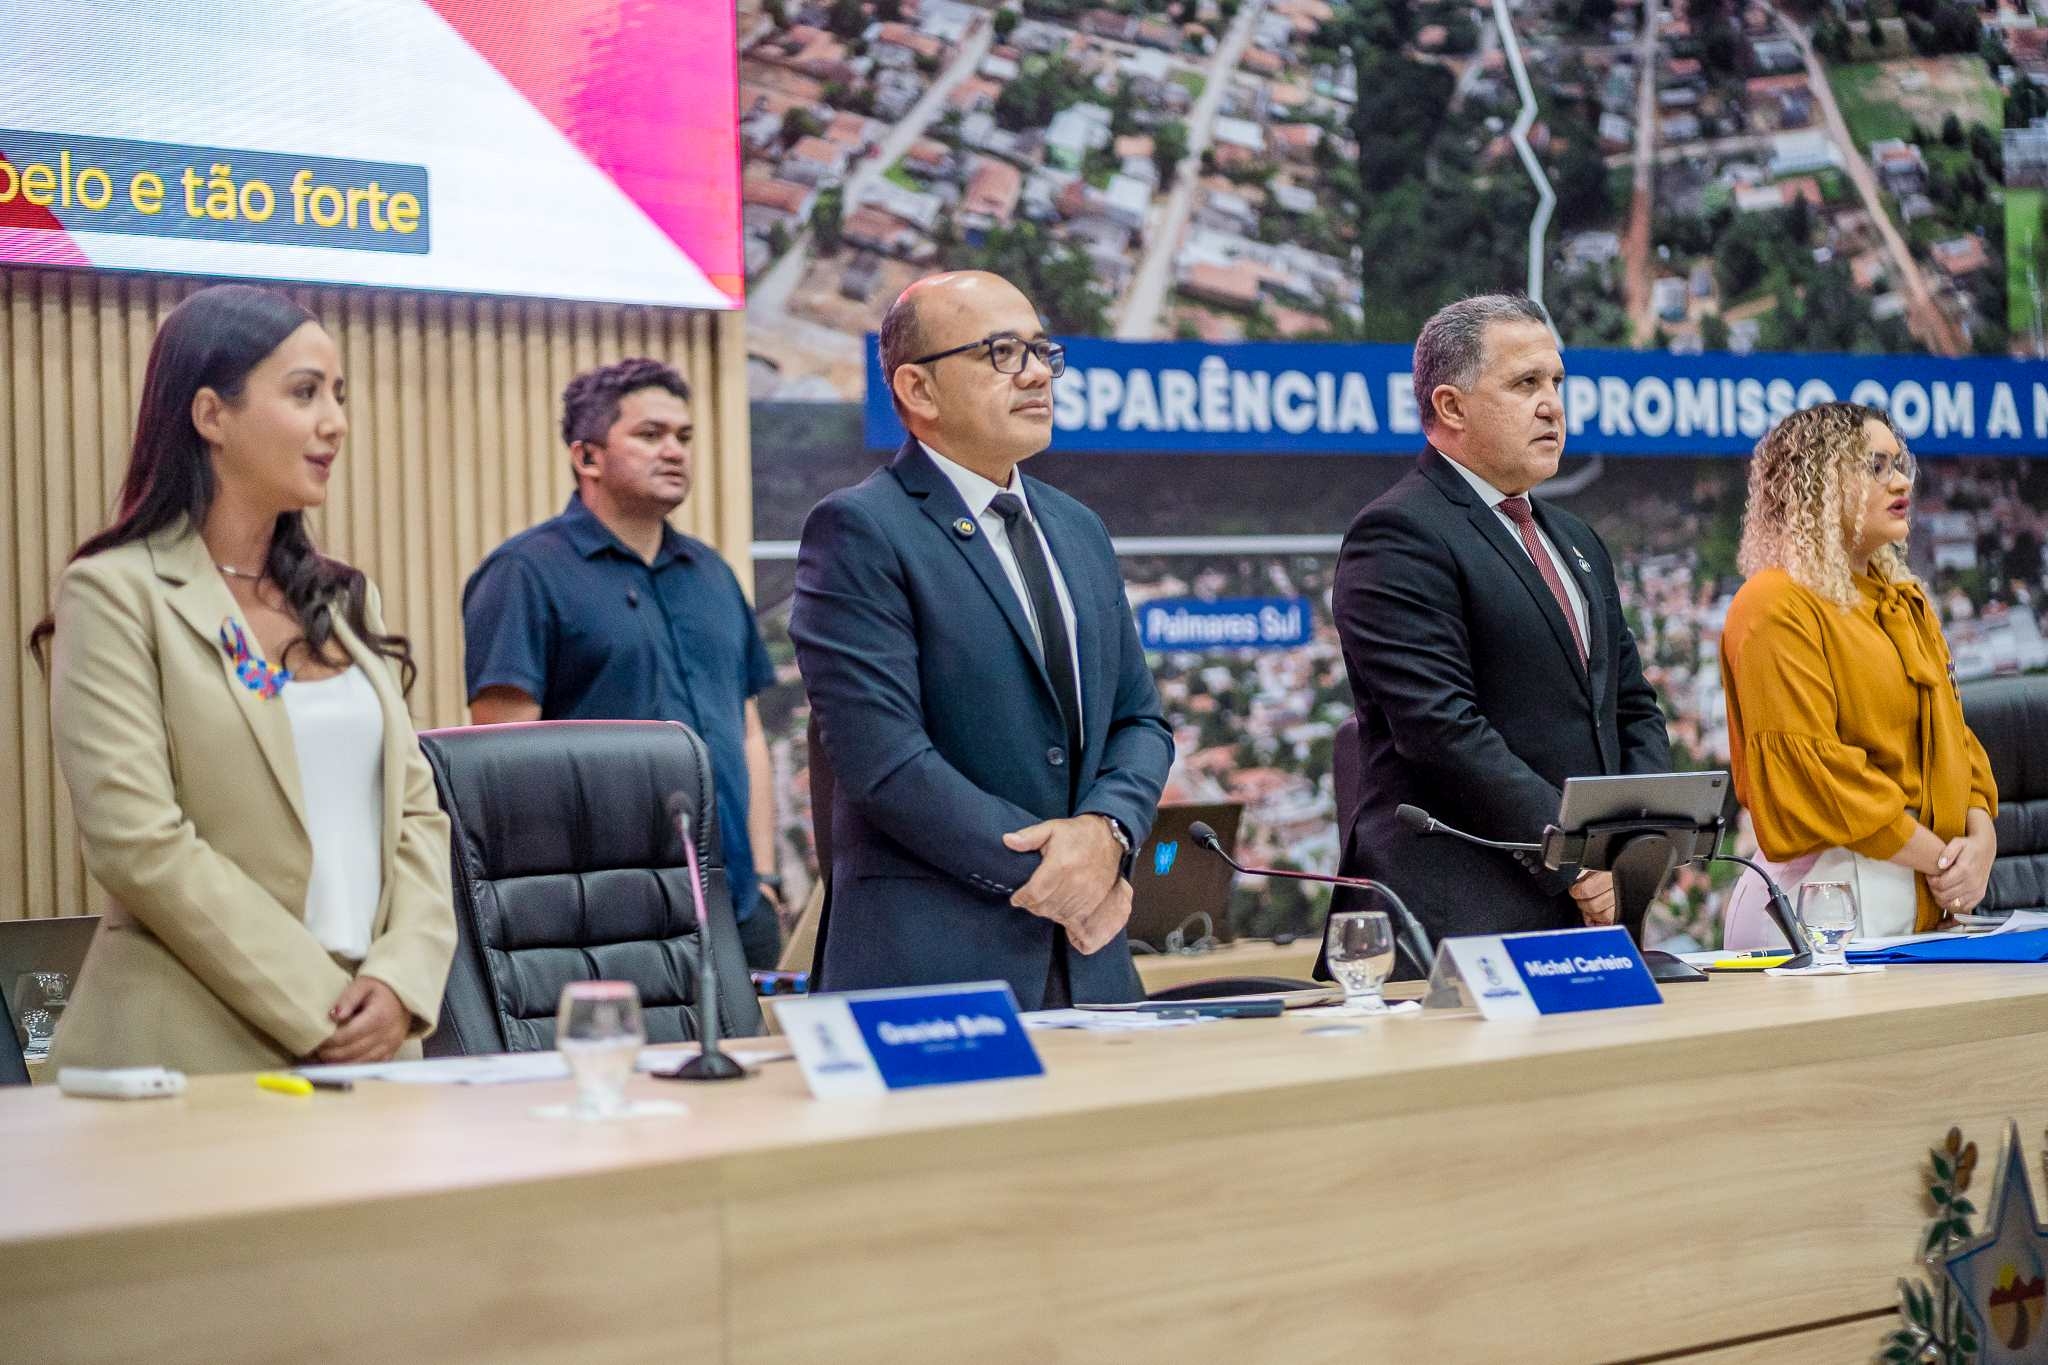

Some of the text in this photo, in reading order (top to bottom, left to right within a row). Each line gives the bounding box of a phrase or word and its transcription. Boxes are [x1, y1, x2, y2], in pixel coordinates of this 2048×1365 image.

[130, 171, 164, 214] e
[182, 163, 275, 223] tão
[291, 170, 421, 234] forte
[1986, 381, 2023, 439] A
[1146, 604, 1302, 644] Palmares Sul
[1523, 954, 1635, 977] Michel Carteiro
